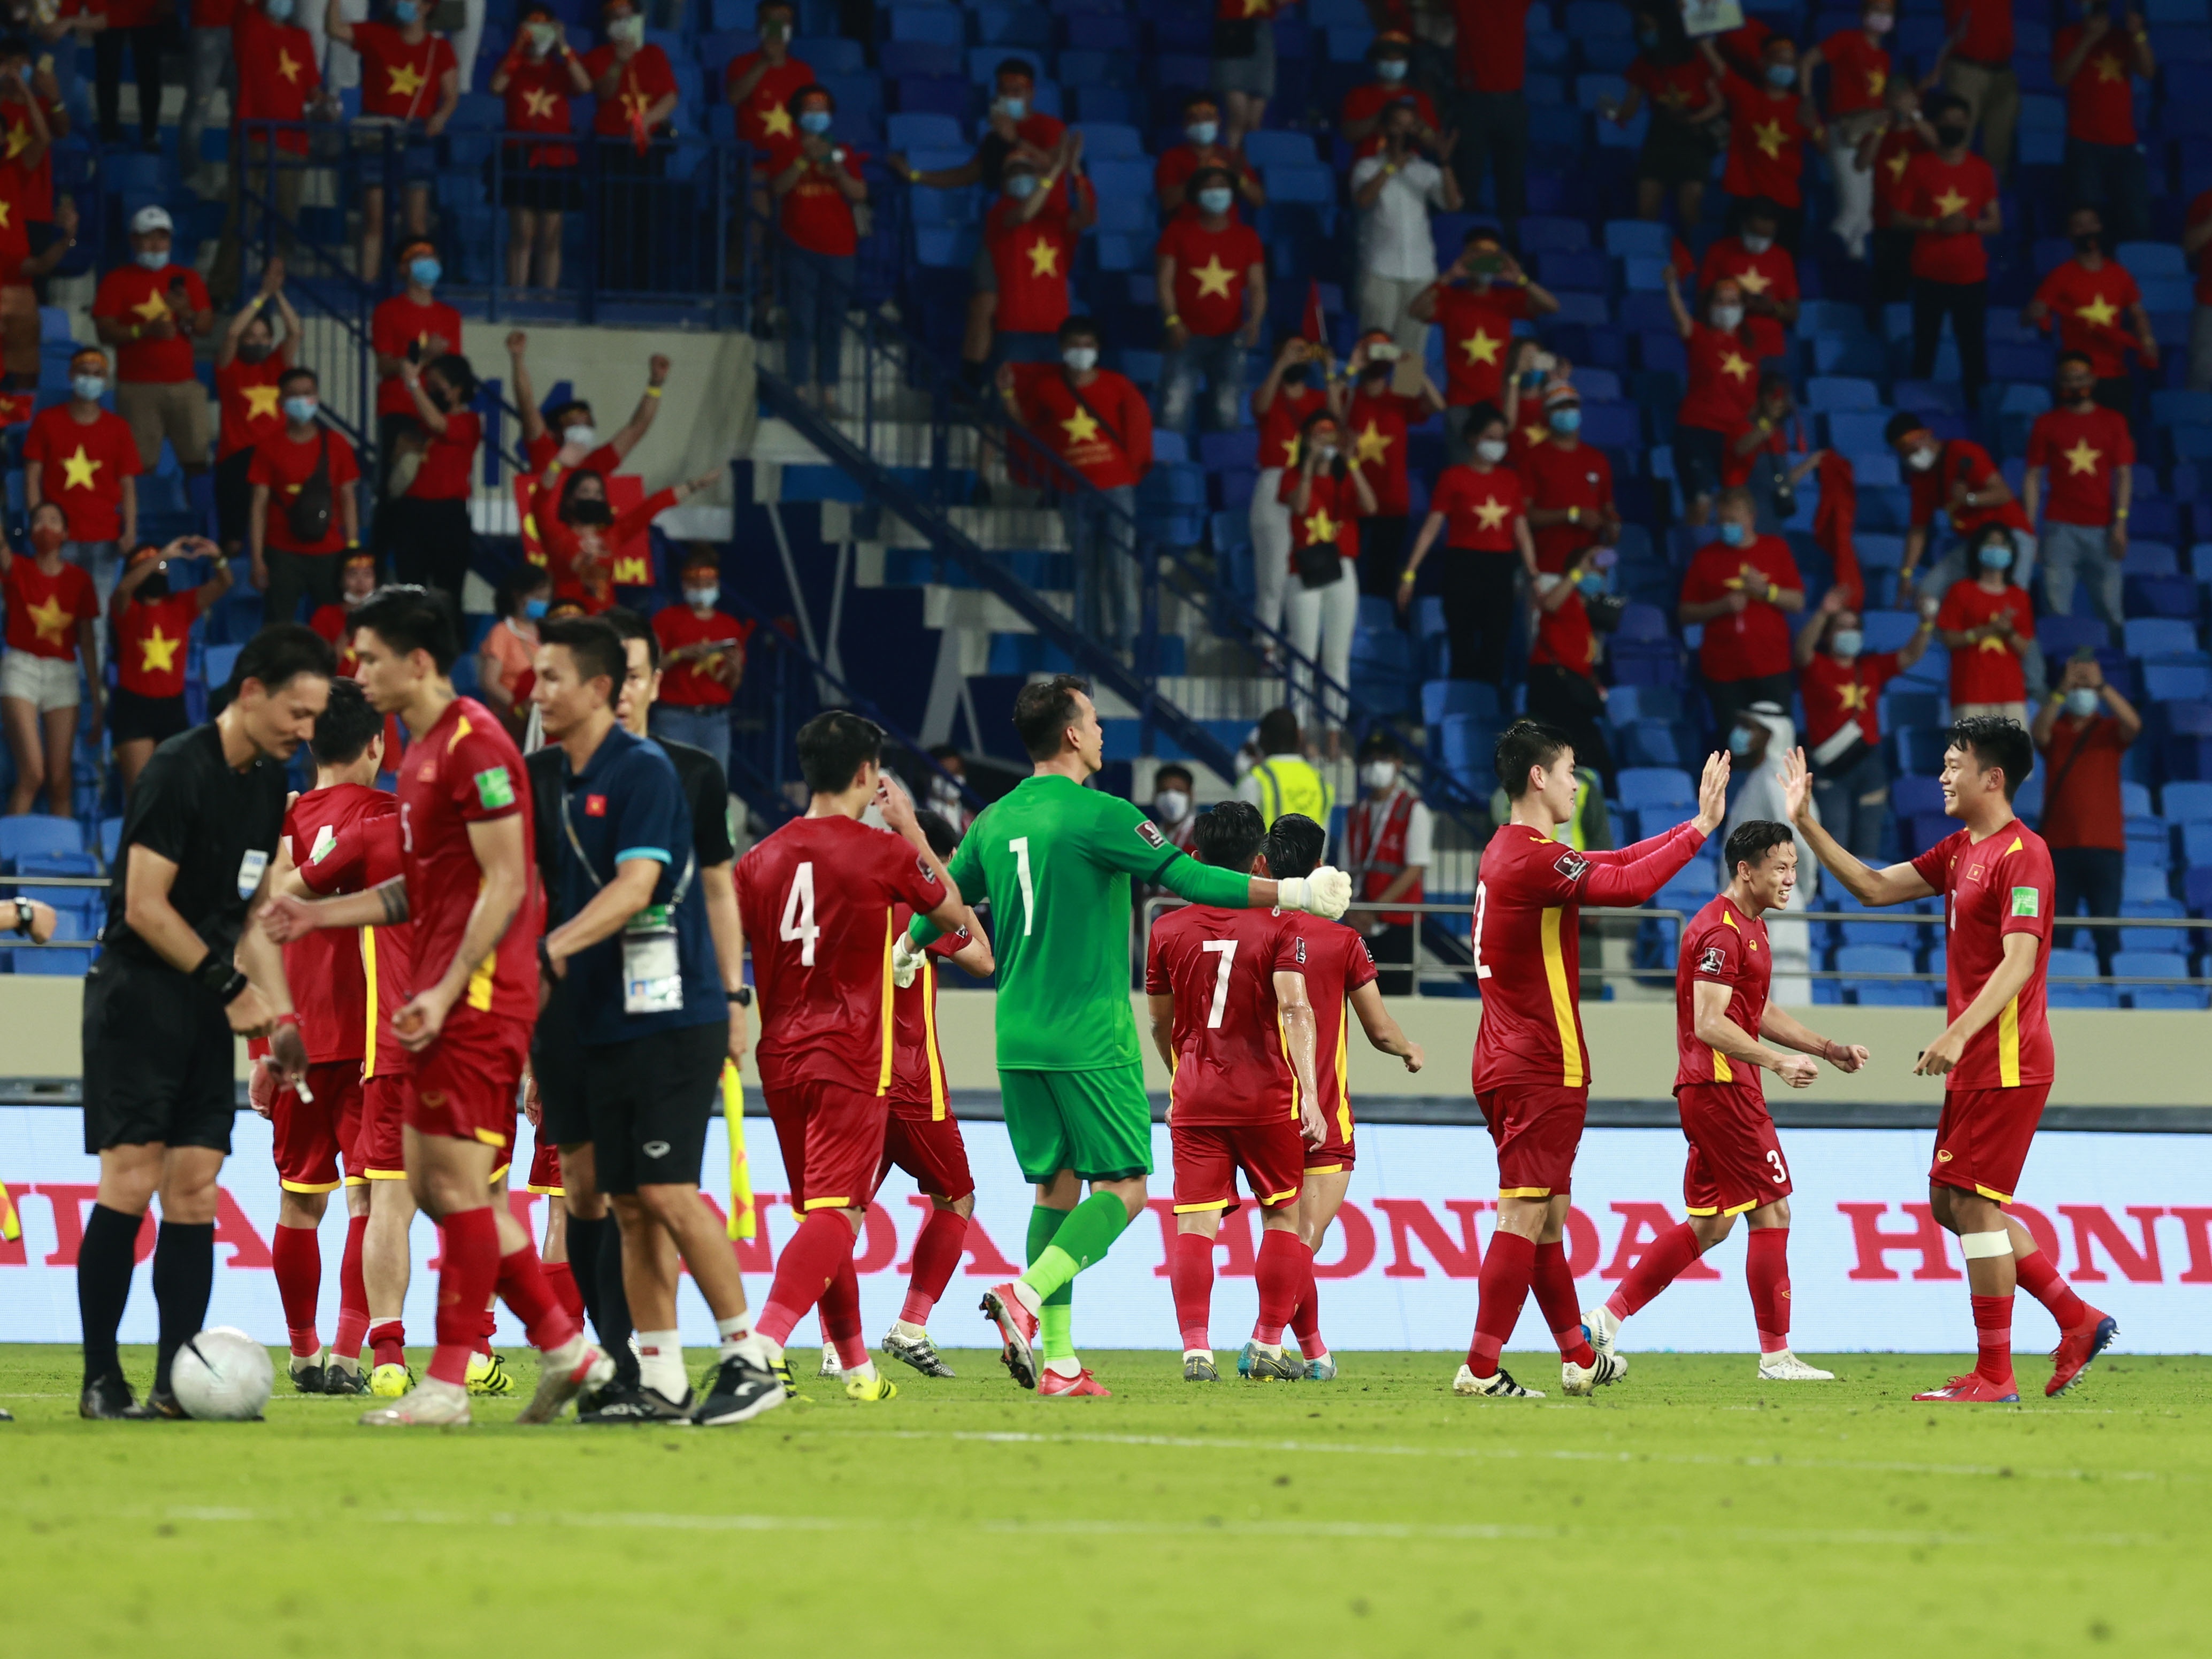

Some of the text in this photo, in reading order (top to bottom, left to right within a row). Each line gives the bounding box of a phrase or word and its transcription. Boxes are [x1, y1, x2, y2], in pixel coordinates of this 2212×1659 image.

[780, 862, 820, 967] 4
[1009, 837, 1033, 936] 1
[1472, 880, 1493, 979] 2
[1202, 939, 1239, 1029] 7
[1766, 1149, 1787, 1184] 3
